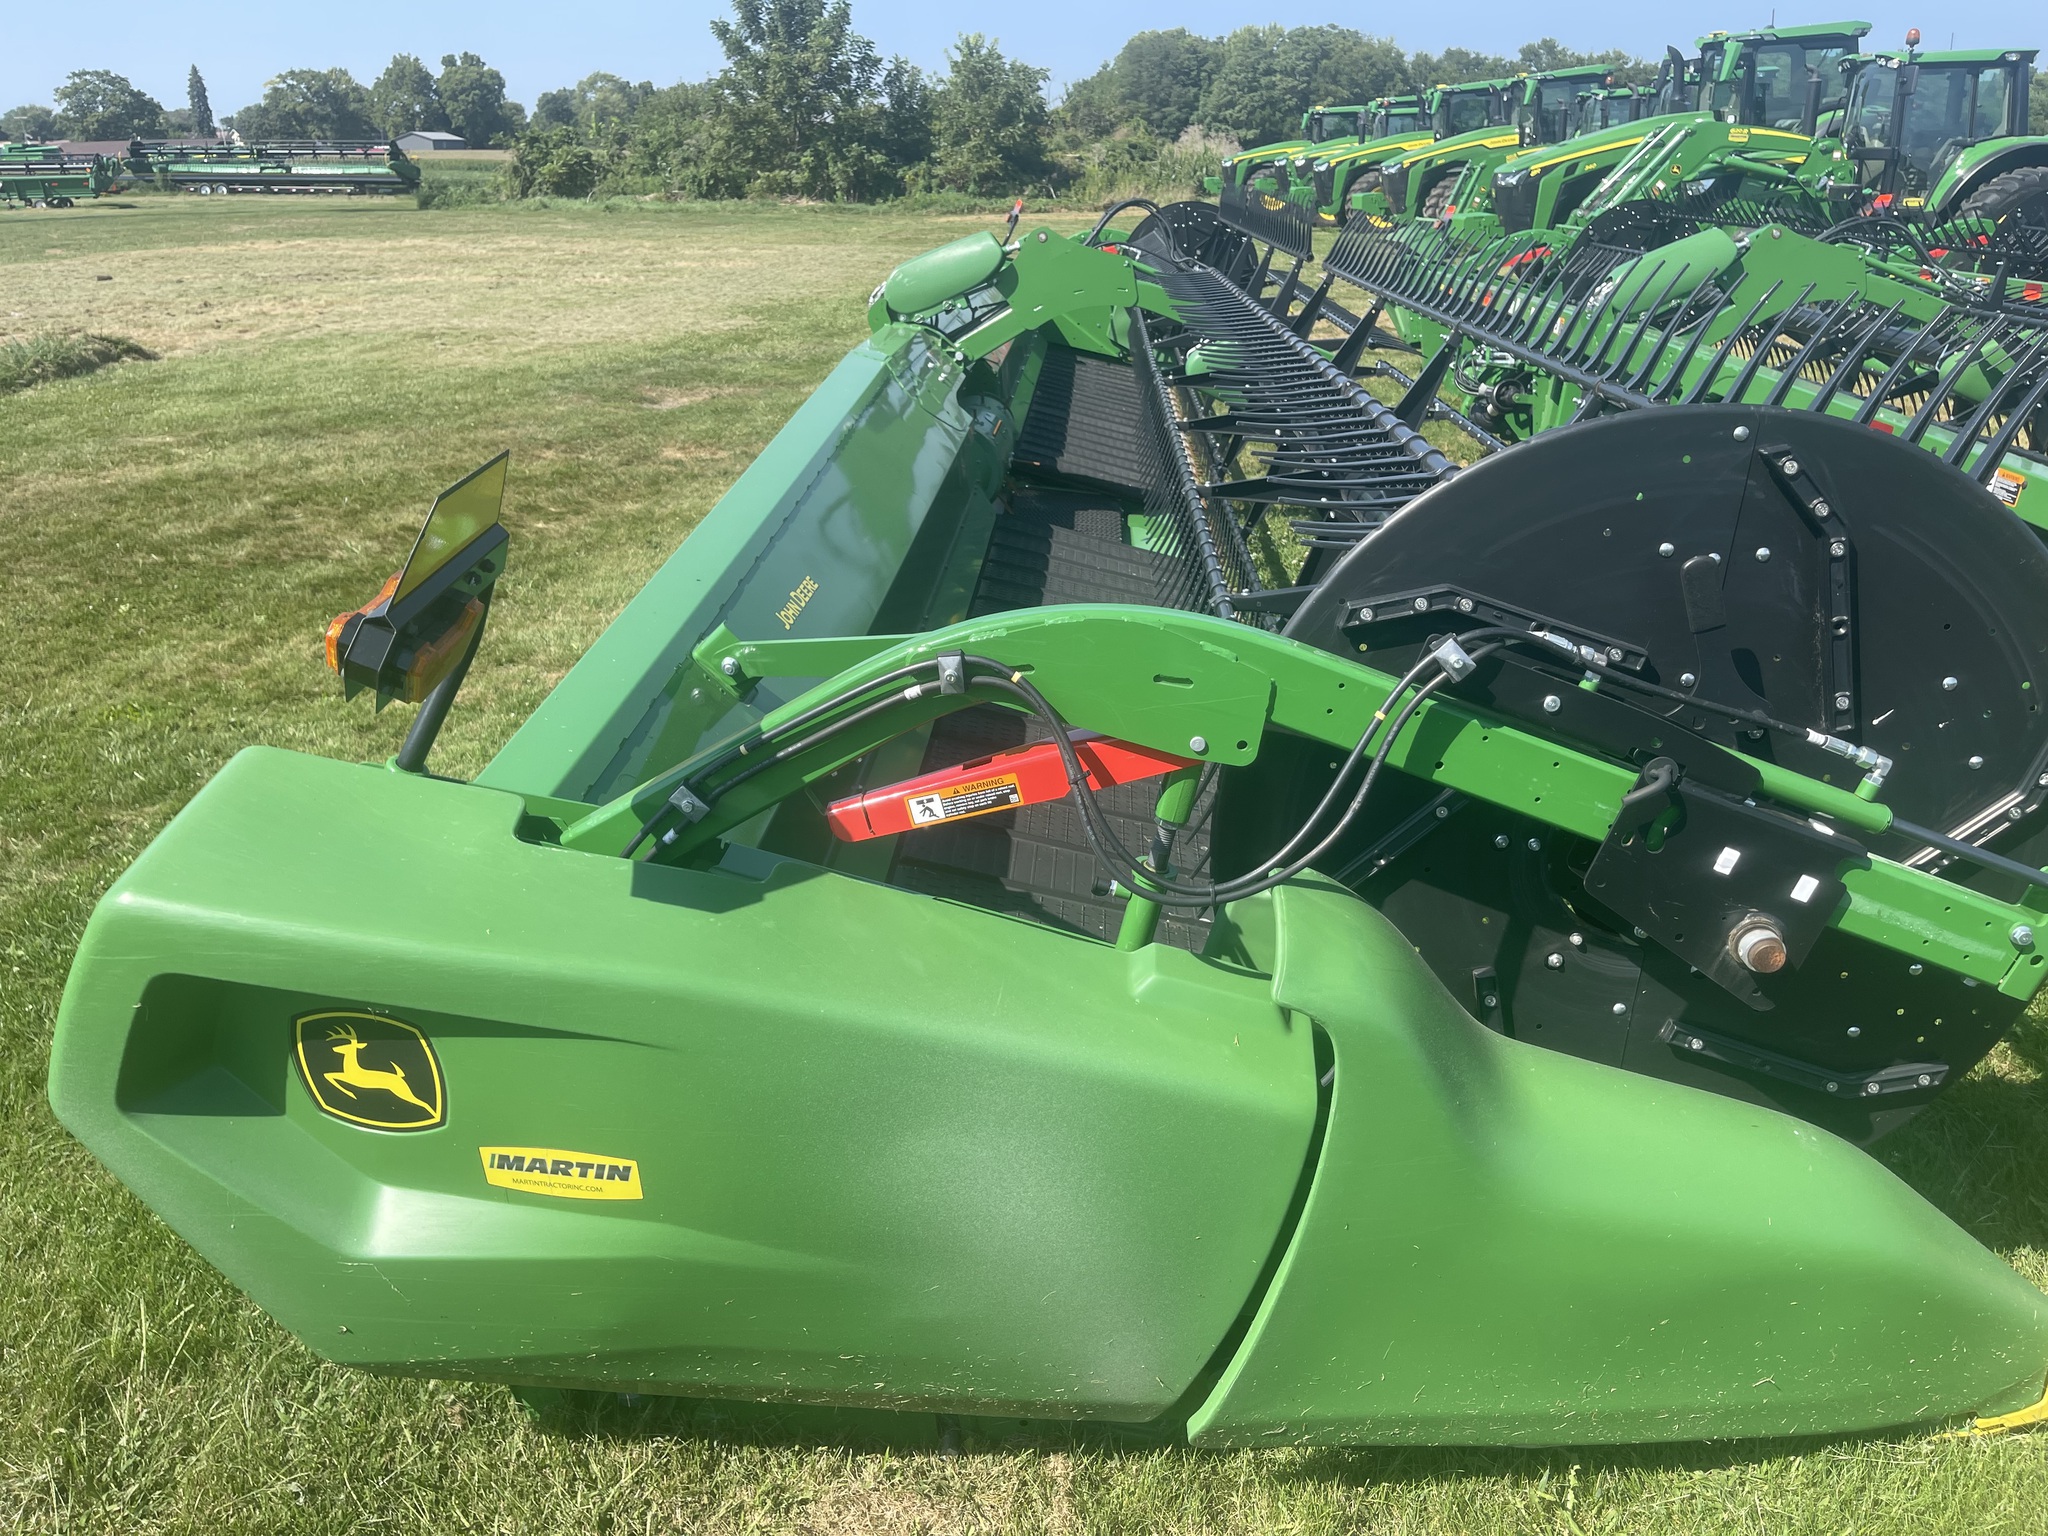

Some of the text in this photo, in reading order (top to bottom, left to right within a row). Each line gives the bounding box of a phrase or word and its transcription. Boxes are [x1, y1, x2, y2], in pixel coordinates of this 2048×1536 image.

[775, 575, 819, 630] JOHN DEERE
[962, 777, 1004, 793] WARNING
[496, 1154, 632, 1182] MARTIN
[512, 1178, 604, 1193] MARTINTRACTORINC.COM
